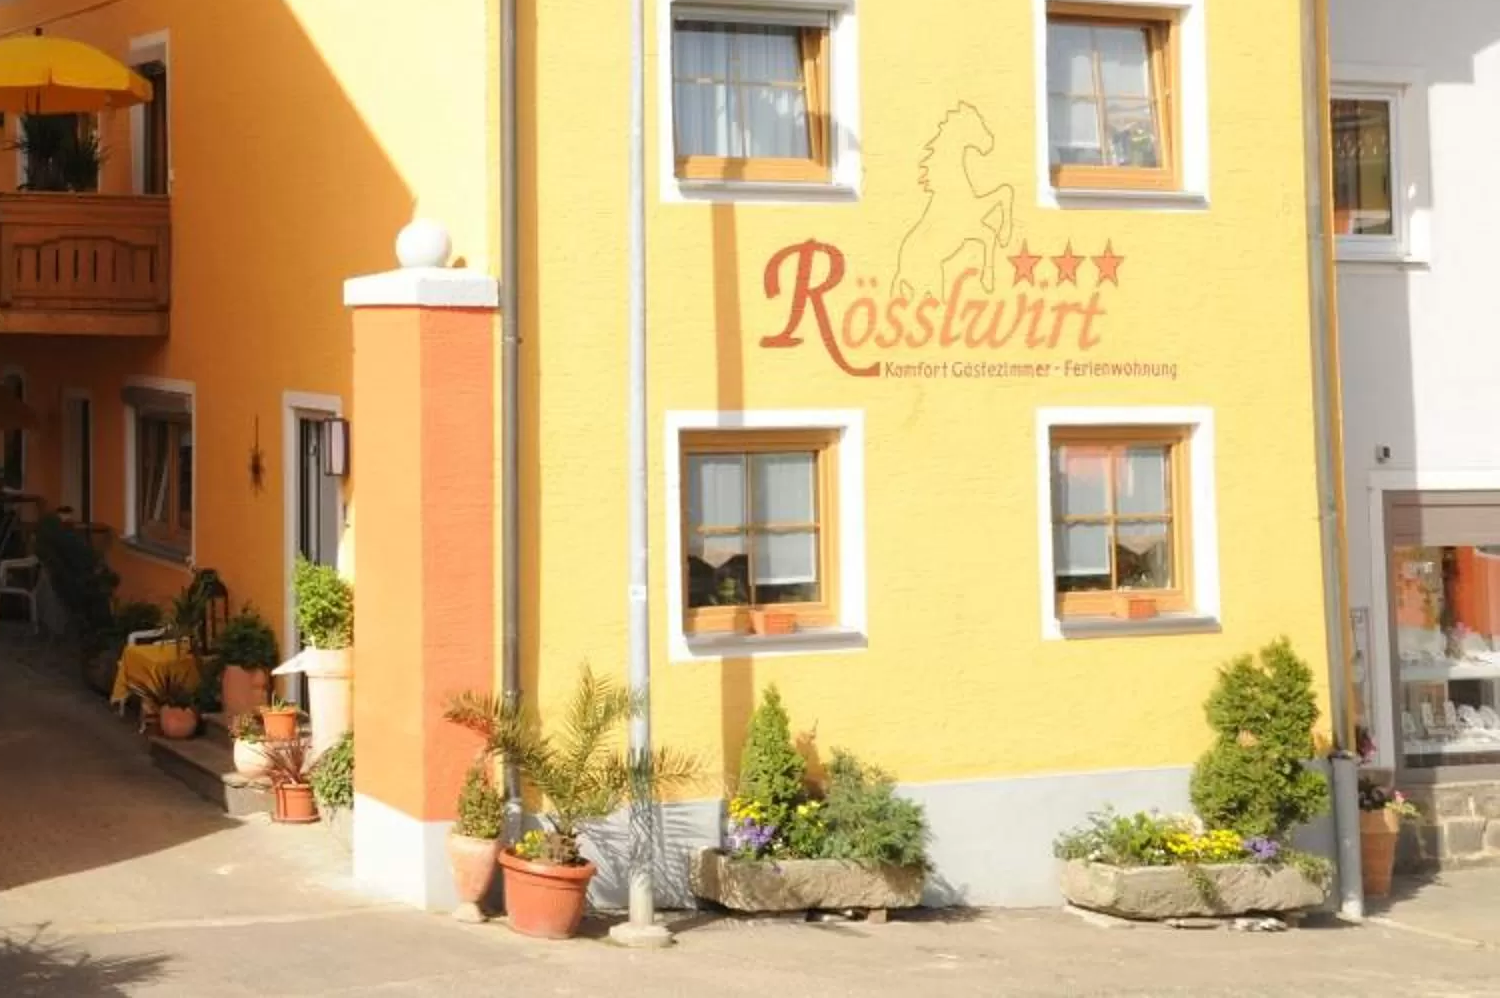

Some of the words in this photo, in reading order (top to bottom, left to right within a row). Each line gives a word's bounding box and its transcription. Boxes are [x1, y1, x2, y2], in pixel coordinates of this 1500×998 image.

[758, 238, 1106, 378] Rösslwirt
[884, 361, 948, 378] Komfort
[951, 360, 1051, 378] Gästezimmer
[1064, 359, 1177, 380] Ferienwohnung
